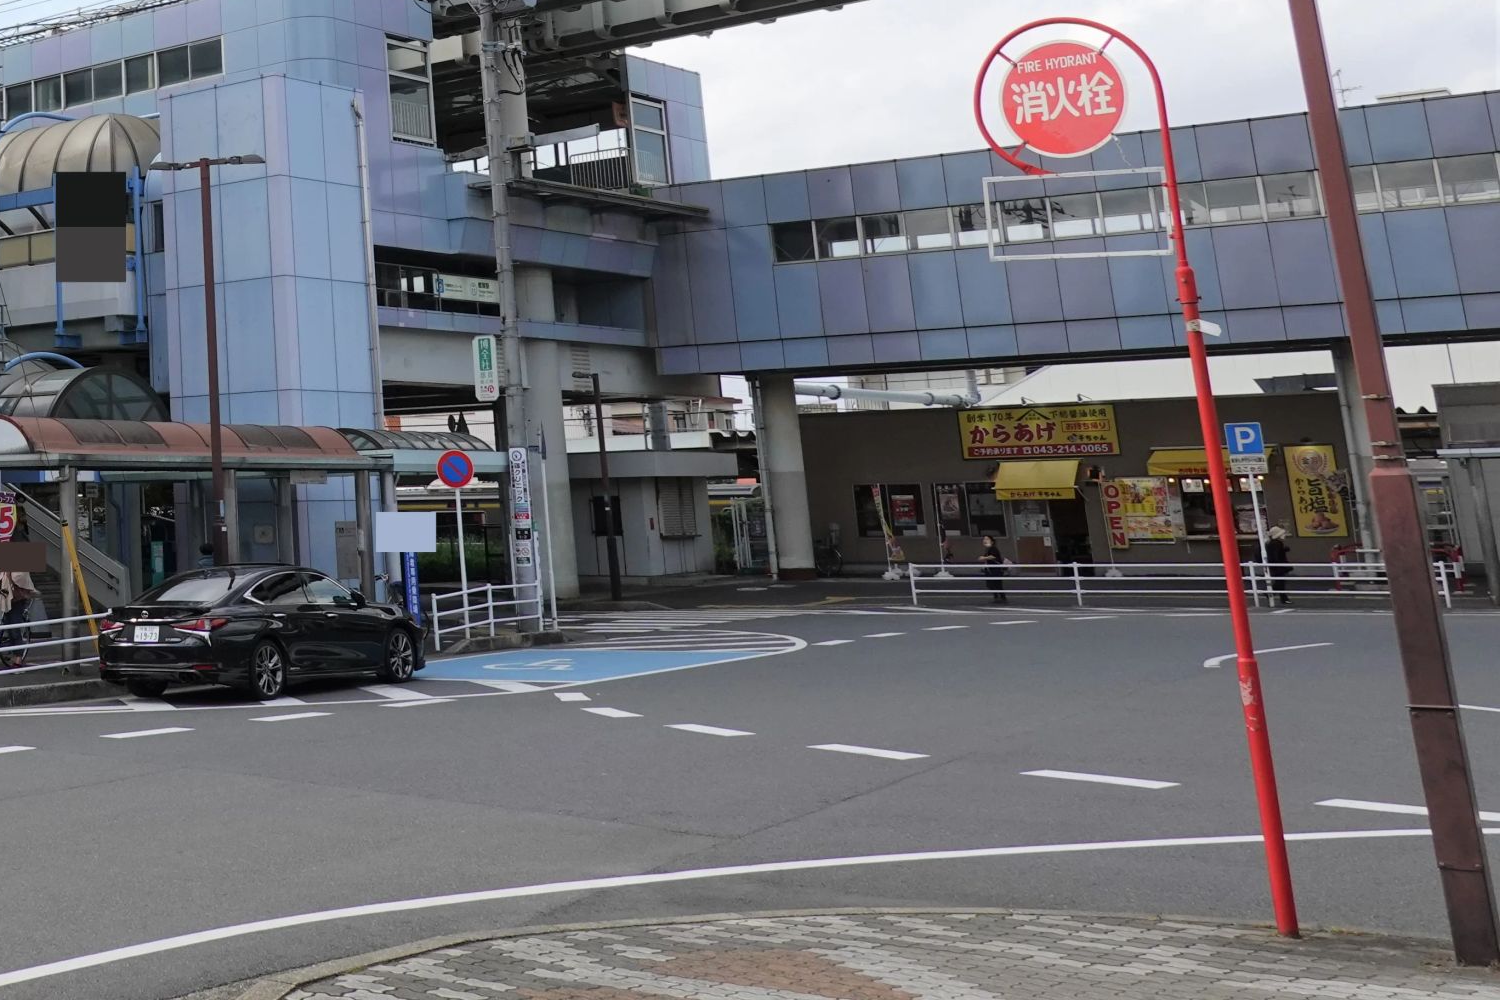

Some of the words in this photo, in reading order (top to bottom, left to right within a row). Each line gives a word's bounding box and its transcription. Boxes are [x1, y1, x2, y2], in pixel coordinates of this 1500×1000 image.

[1016, 59, 1042, 75] FIRE
[1045, 51, 1098, 71] HYDRANT
[1011, 70, 1117, 125] 消火栓
[969, 421, 1057, 444] からあげ
[1033, 443, 1109, 454] 043-214-0065
[1103, 484, 1126, 546] OPEN
